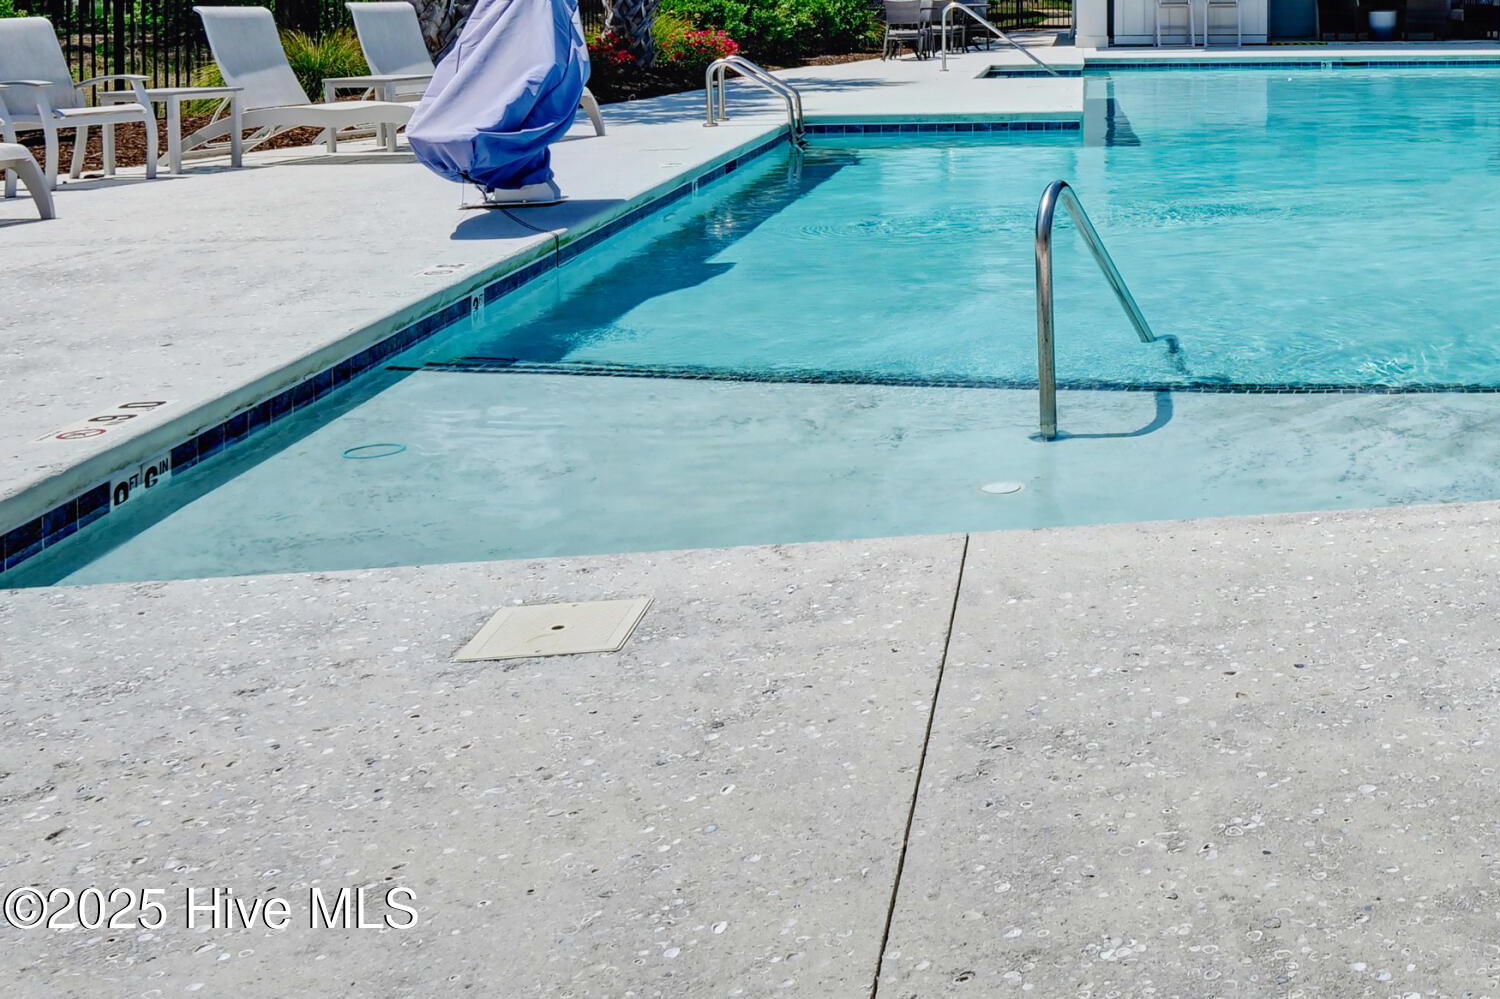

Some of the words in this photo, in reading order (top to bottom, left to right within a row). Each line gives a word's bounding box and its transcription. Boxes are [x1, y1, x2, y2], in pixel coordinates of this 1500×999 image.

[113, 481, 129, 506] 0
[129, 473, 140, 491] FT
[159, 458, 169, 475] IN
